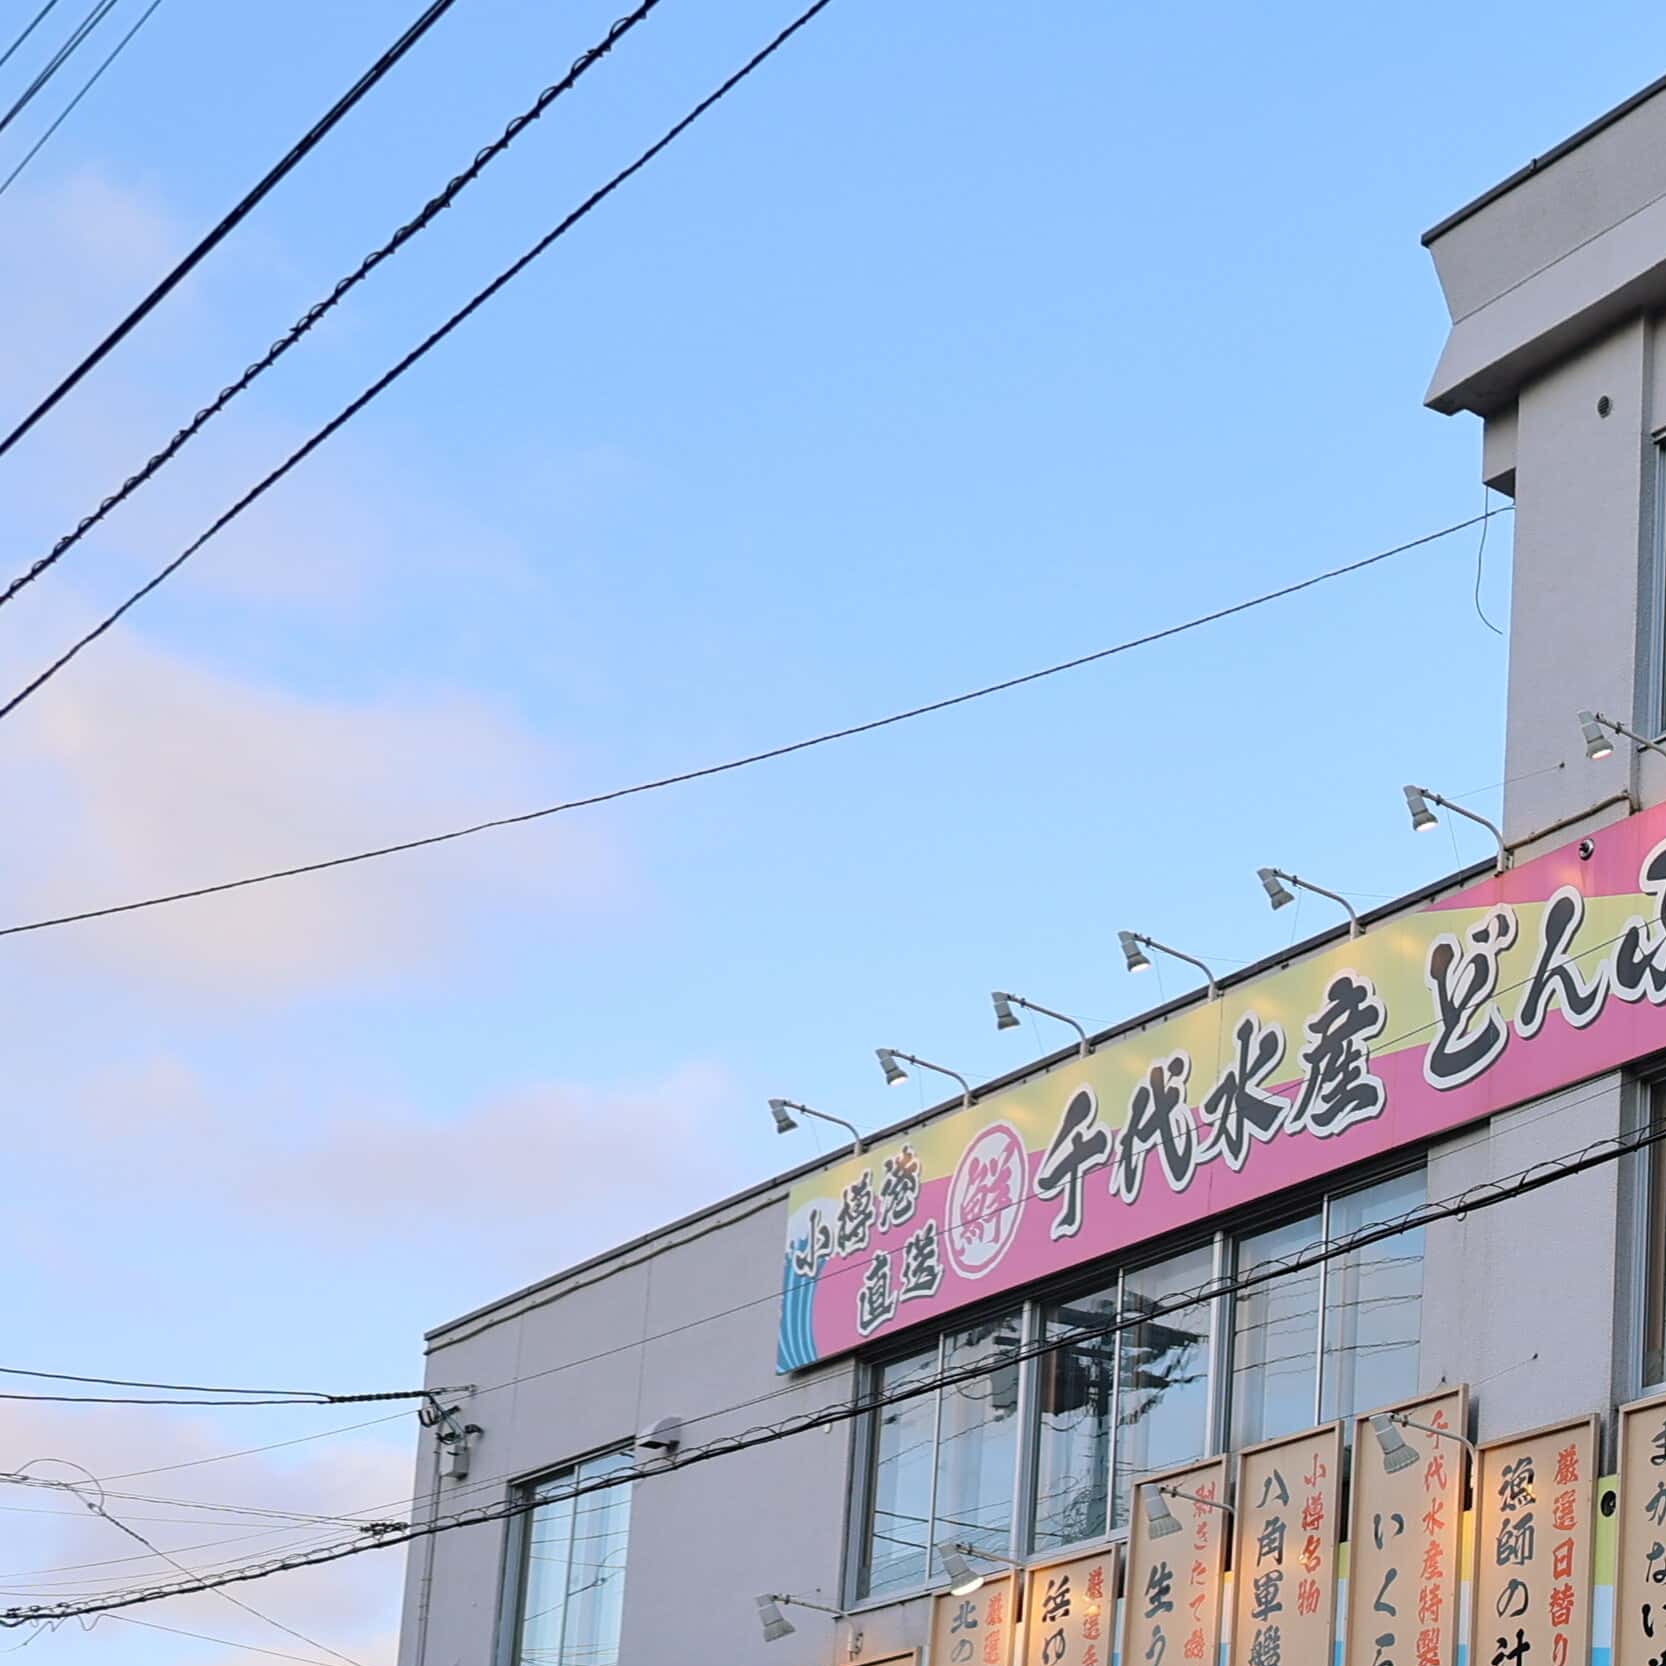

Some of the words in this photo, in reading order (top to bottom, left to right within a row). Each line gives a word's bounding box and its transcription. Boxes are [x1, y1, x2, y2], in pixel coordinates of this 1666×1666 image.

[1037, 969, 1387, 1240] 千代水産
[793, 1147, 921, 1275] 小樽港
[960, 1149, 1013, 1258] 鮮
[857, 1222, 944, 1336] 直送
[1296, 1453, 1327, 1616] 小樽名物
